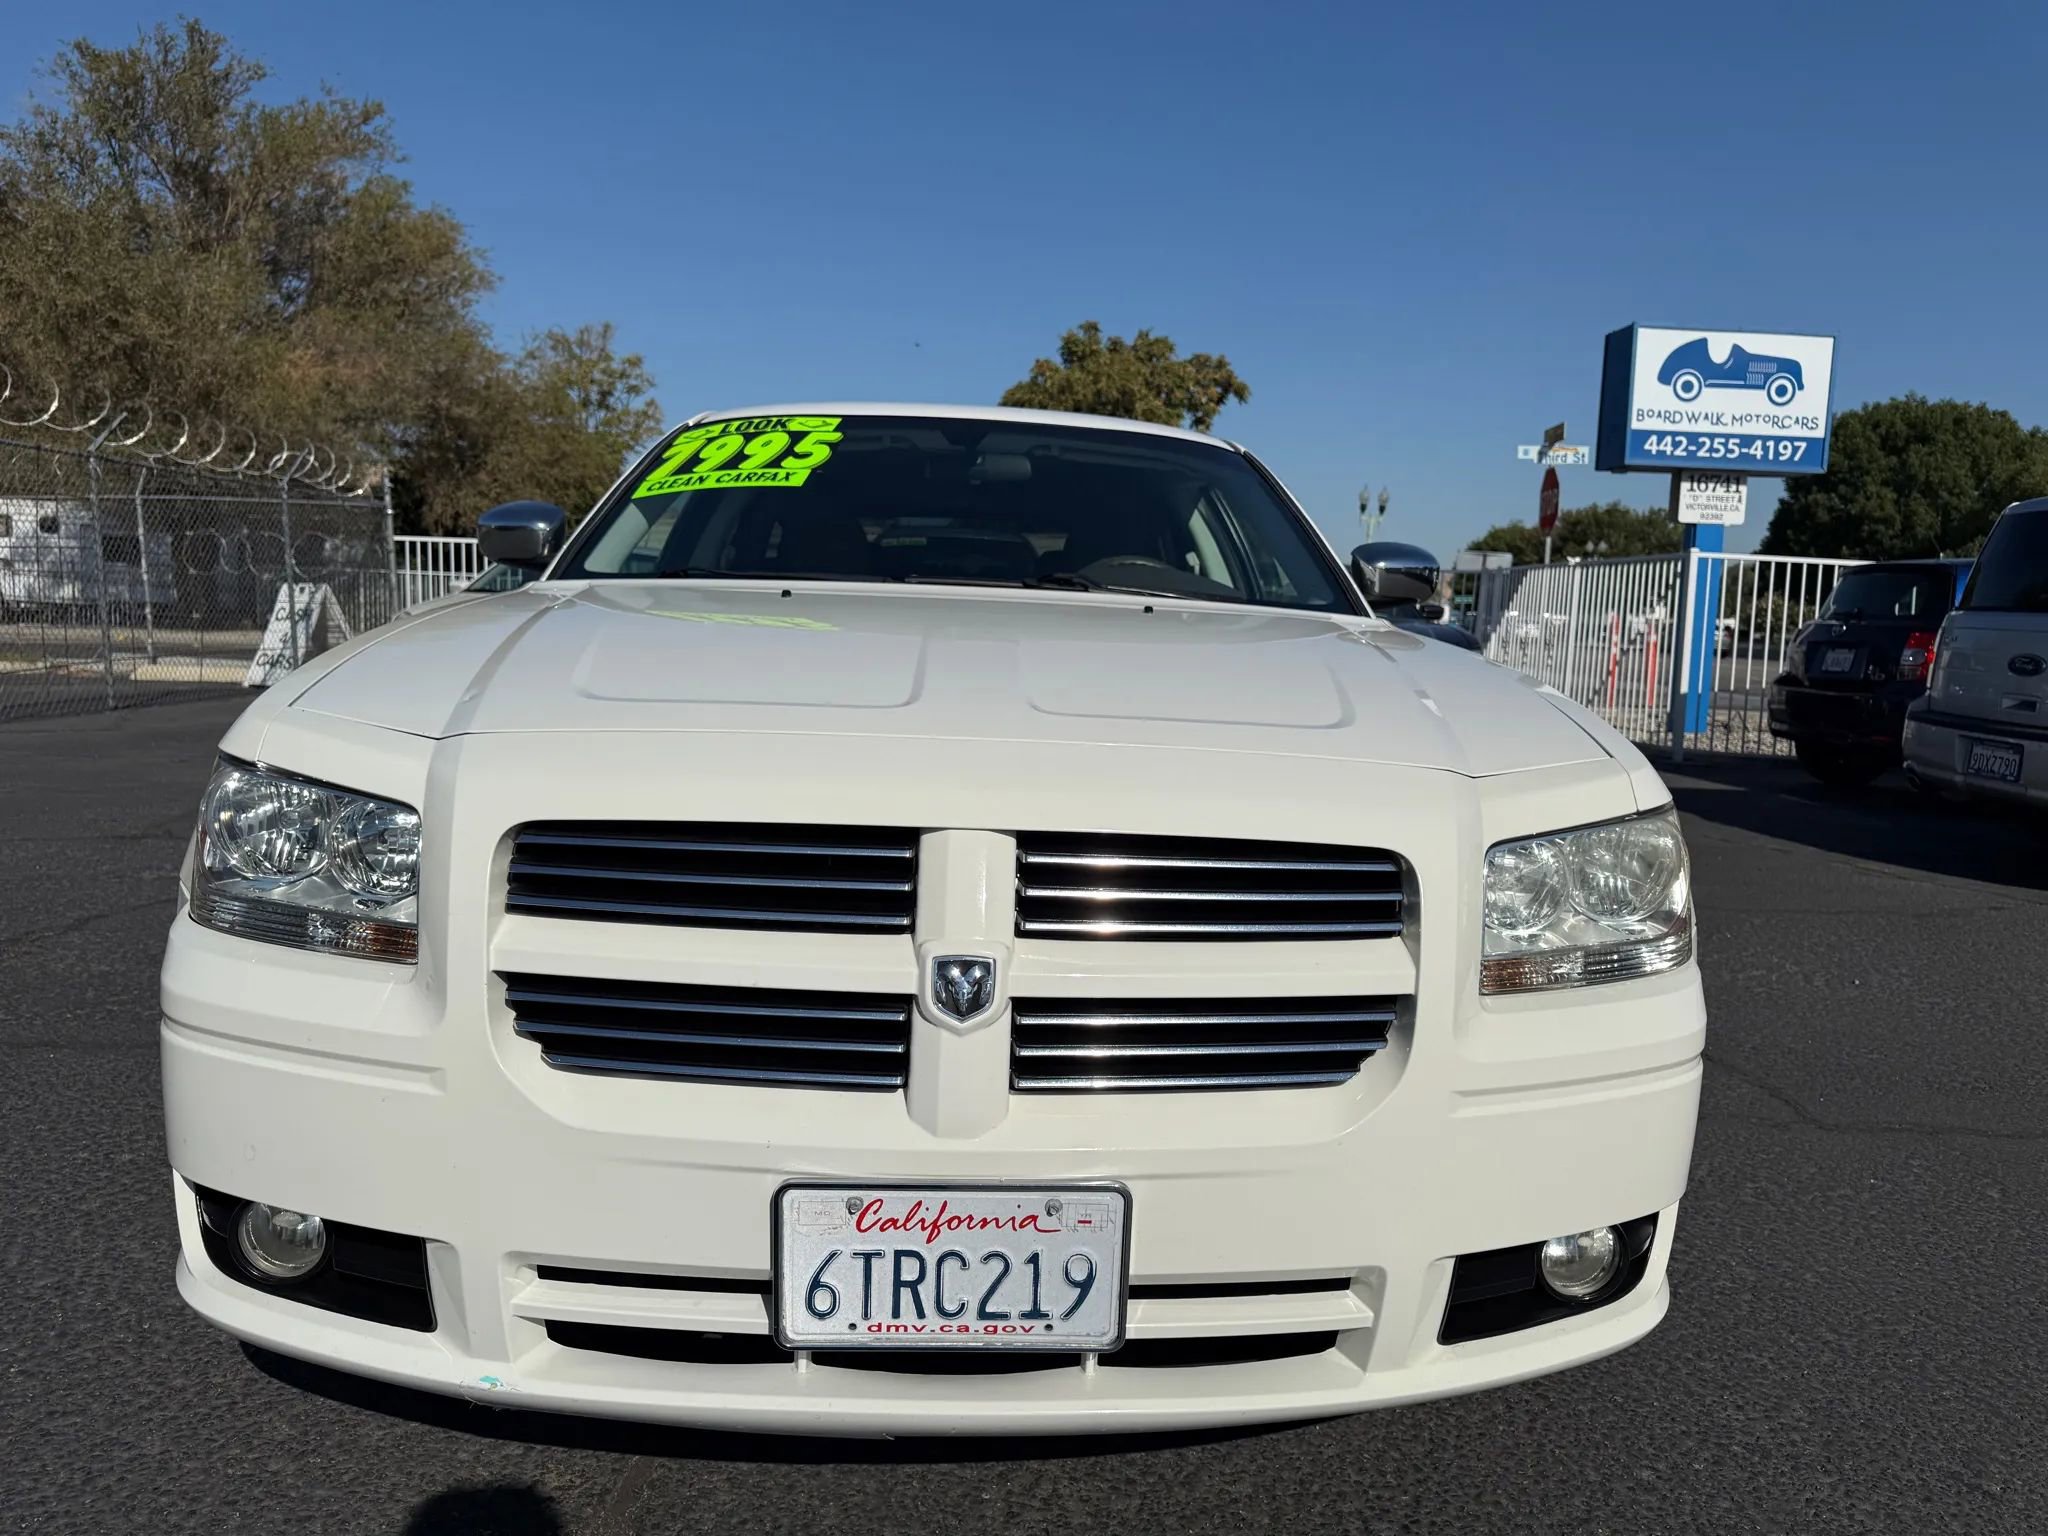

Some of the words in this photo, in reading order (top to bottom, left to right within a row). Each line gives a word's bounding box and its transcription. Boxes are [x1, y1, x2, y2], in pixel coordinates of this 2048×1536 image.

[720, 419, 793, 434] LOOK
[1636, 408, 1728, 426] BOARDWALK
[1731, 413, 1819, 430] MOTORCARS
[1572, 451, 1585, 464] St
[1643, 434, 1807, 461] 442-255-4197
[647, 475, 711, 492] CLEAN
[715, 471, 797, 483] CARFAX
[1686, 474, 1742, 494] 16741
[1705, 495, 1736, 504] STREET
[256, 653, 294, 670] CARS
[854, 1198, 1062, 1244] California
[804, 1248, 1098, 1321] 6TRC219
[867, 1322, 1036, 1335] dmv.ca.gov
